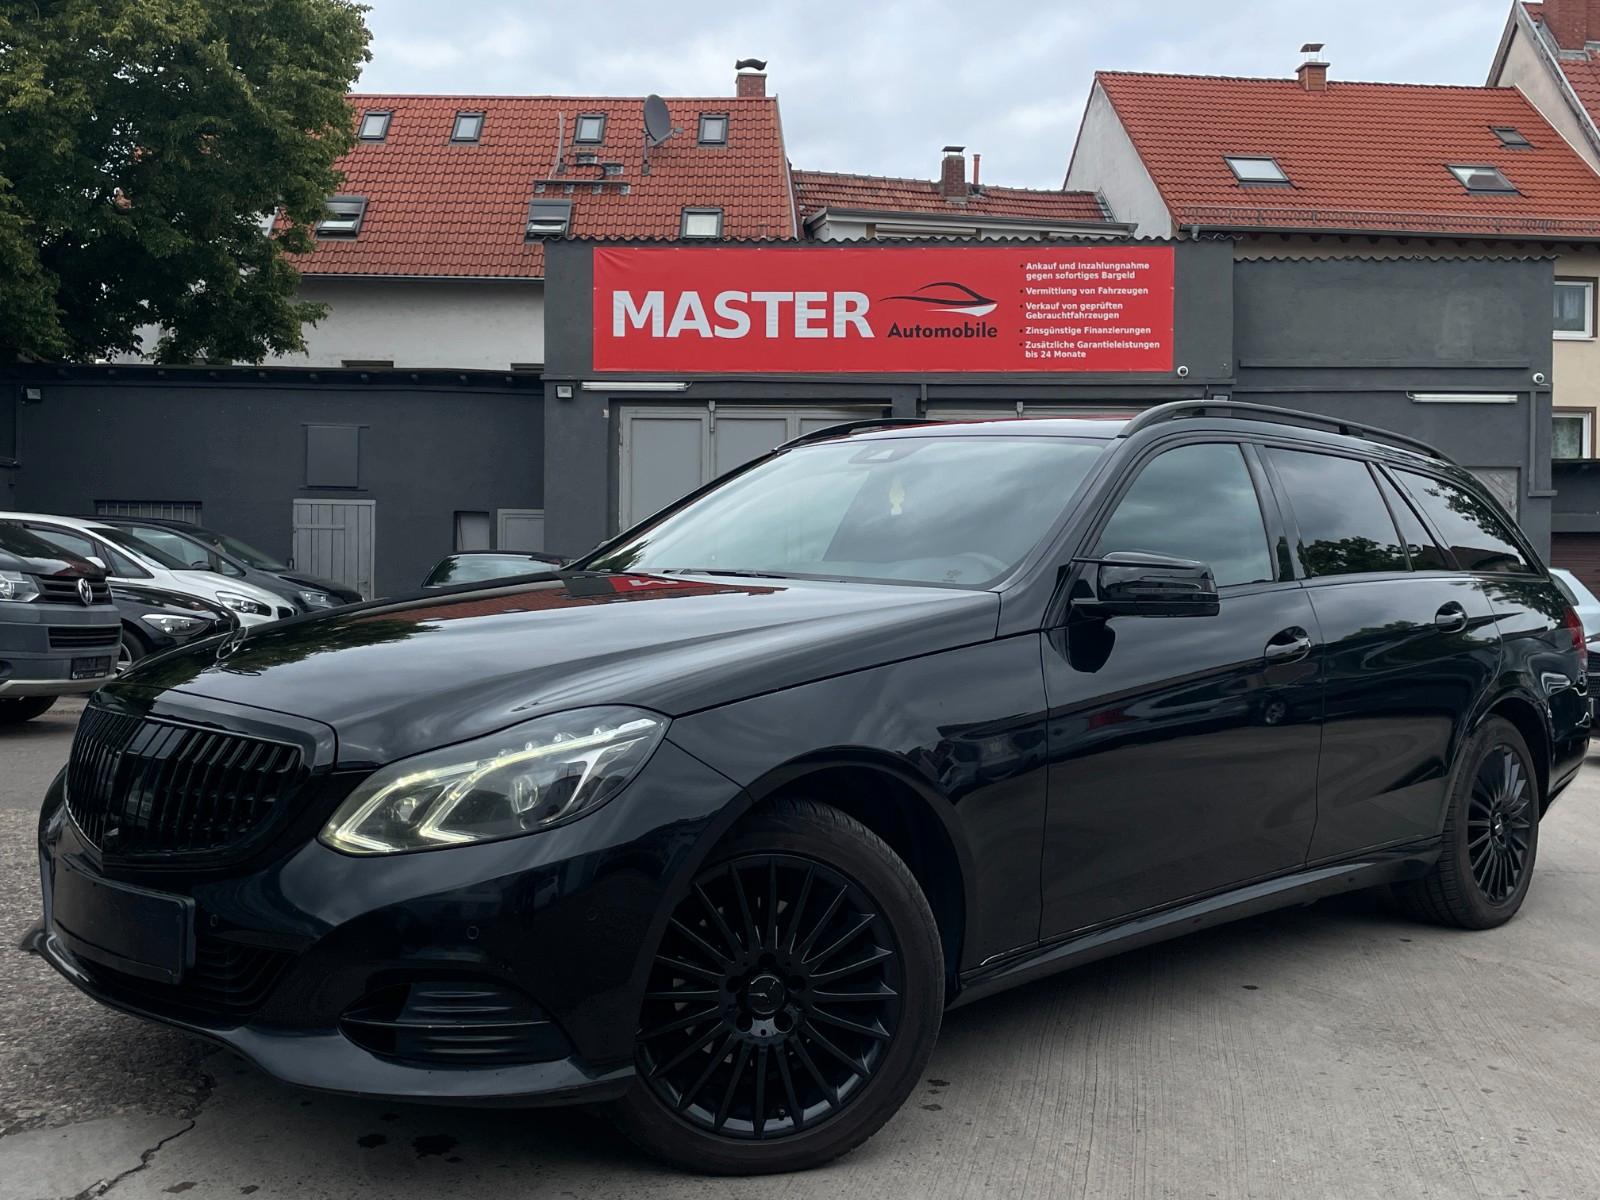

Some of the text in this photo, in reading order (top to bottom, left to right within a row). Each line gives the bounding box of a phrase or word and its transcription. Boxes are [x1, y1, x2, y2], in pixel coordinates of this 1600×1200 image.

[1078, 262, 1150, 271] Inzahlungnahme
[1056, 272, 1099, 280] sofortiges
[1102, 272, 1135, 280] Bargeld
[1026, 288, 1077, 296] Vermittlung
[1098, 287, 1148, 296] Fahrzeugen
[1080, 302, 1123, 311] geprüften
[612, 290, 875, 339] MASTER
[887, 322, 998, 338] Automobile
[1026, 327, 1151, 335] Zinsgünstige Finanzierungen
[1077, 341, 1160, 349] Garantieleistungen
